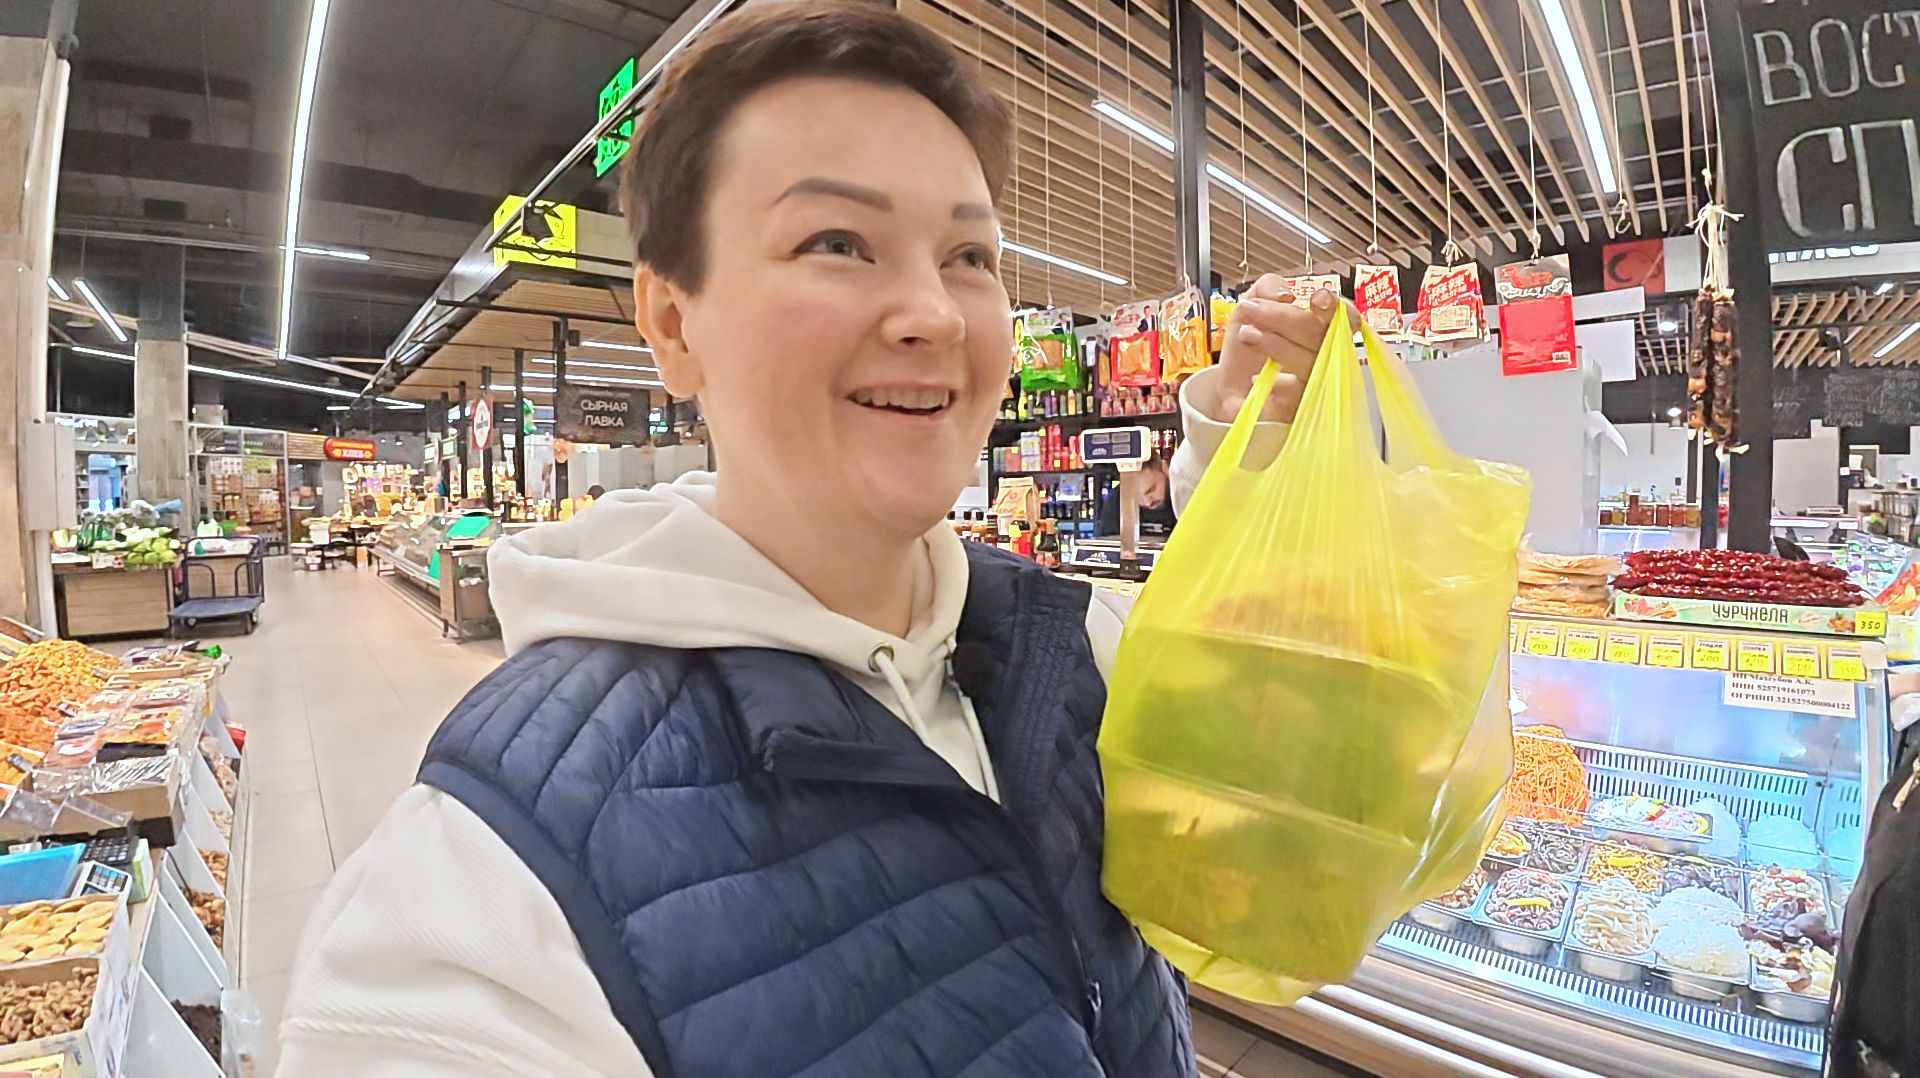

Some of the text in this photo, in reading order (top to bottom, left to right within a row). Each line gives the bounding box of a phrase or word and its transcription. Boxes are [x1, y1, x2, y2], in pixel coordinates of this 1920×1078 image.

[580, 399, 628, 412] СЫРНАЯ
[584, 414, 624, 427] ЛАВКА
[1860, 621, 1881, 630] 350
